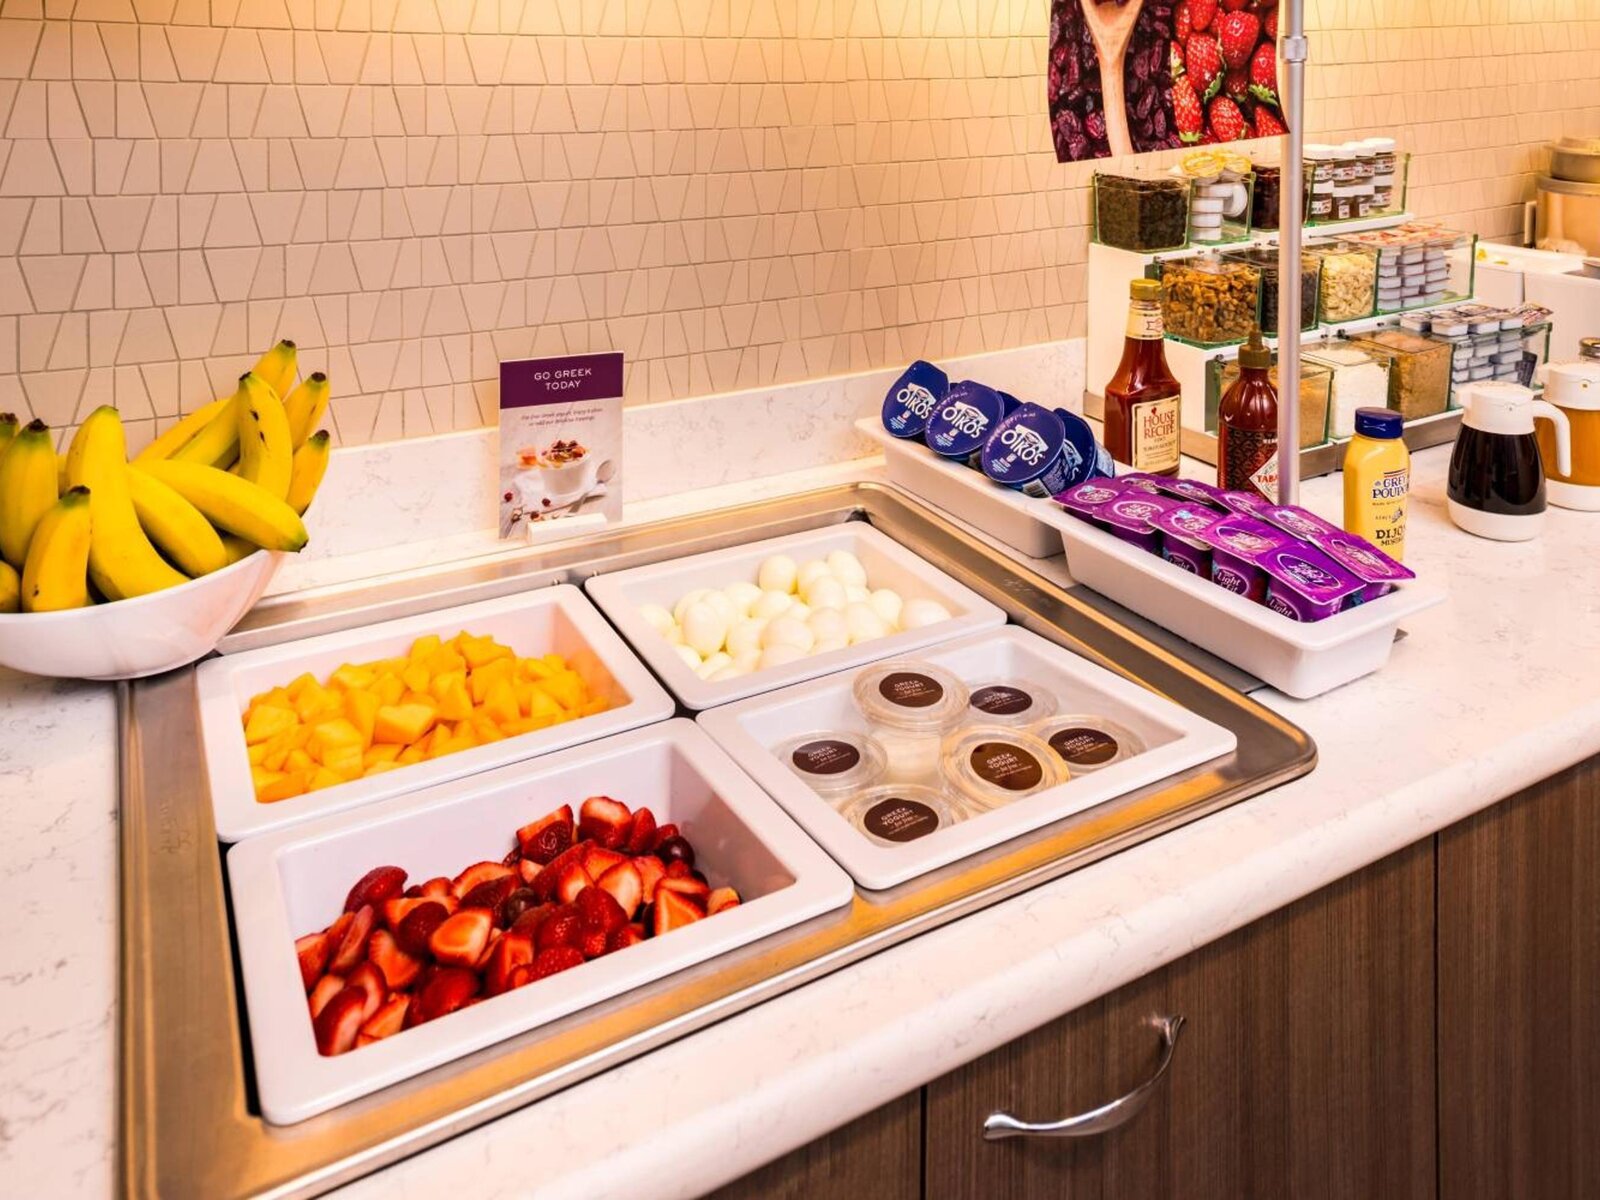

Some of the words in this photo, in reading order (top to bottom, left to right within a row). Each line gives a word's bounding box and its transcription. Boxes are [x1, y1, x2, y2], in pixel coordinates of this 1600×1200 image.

[534, 371, 551, 380] GO
[554, 368, 592, 379] GREEK
[545, 380, 581, 390] TODAY
[942, 406, 984, 438] OIKOS
[1143, 410, 1175, 428] HOUSE
[1144, 420, 1175, 440] RECIPE
[1001, 430, 1043, 466] OIKOS
[1217, 571, 1241, 587] Light
[986, 753, 1012, 764] GREEK
[988, 756, 1018, 769] YOGURT
[881, 807, 906, 821] GREEK
[882, 810, 913, 826] YOGURT
